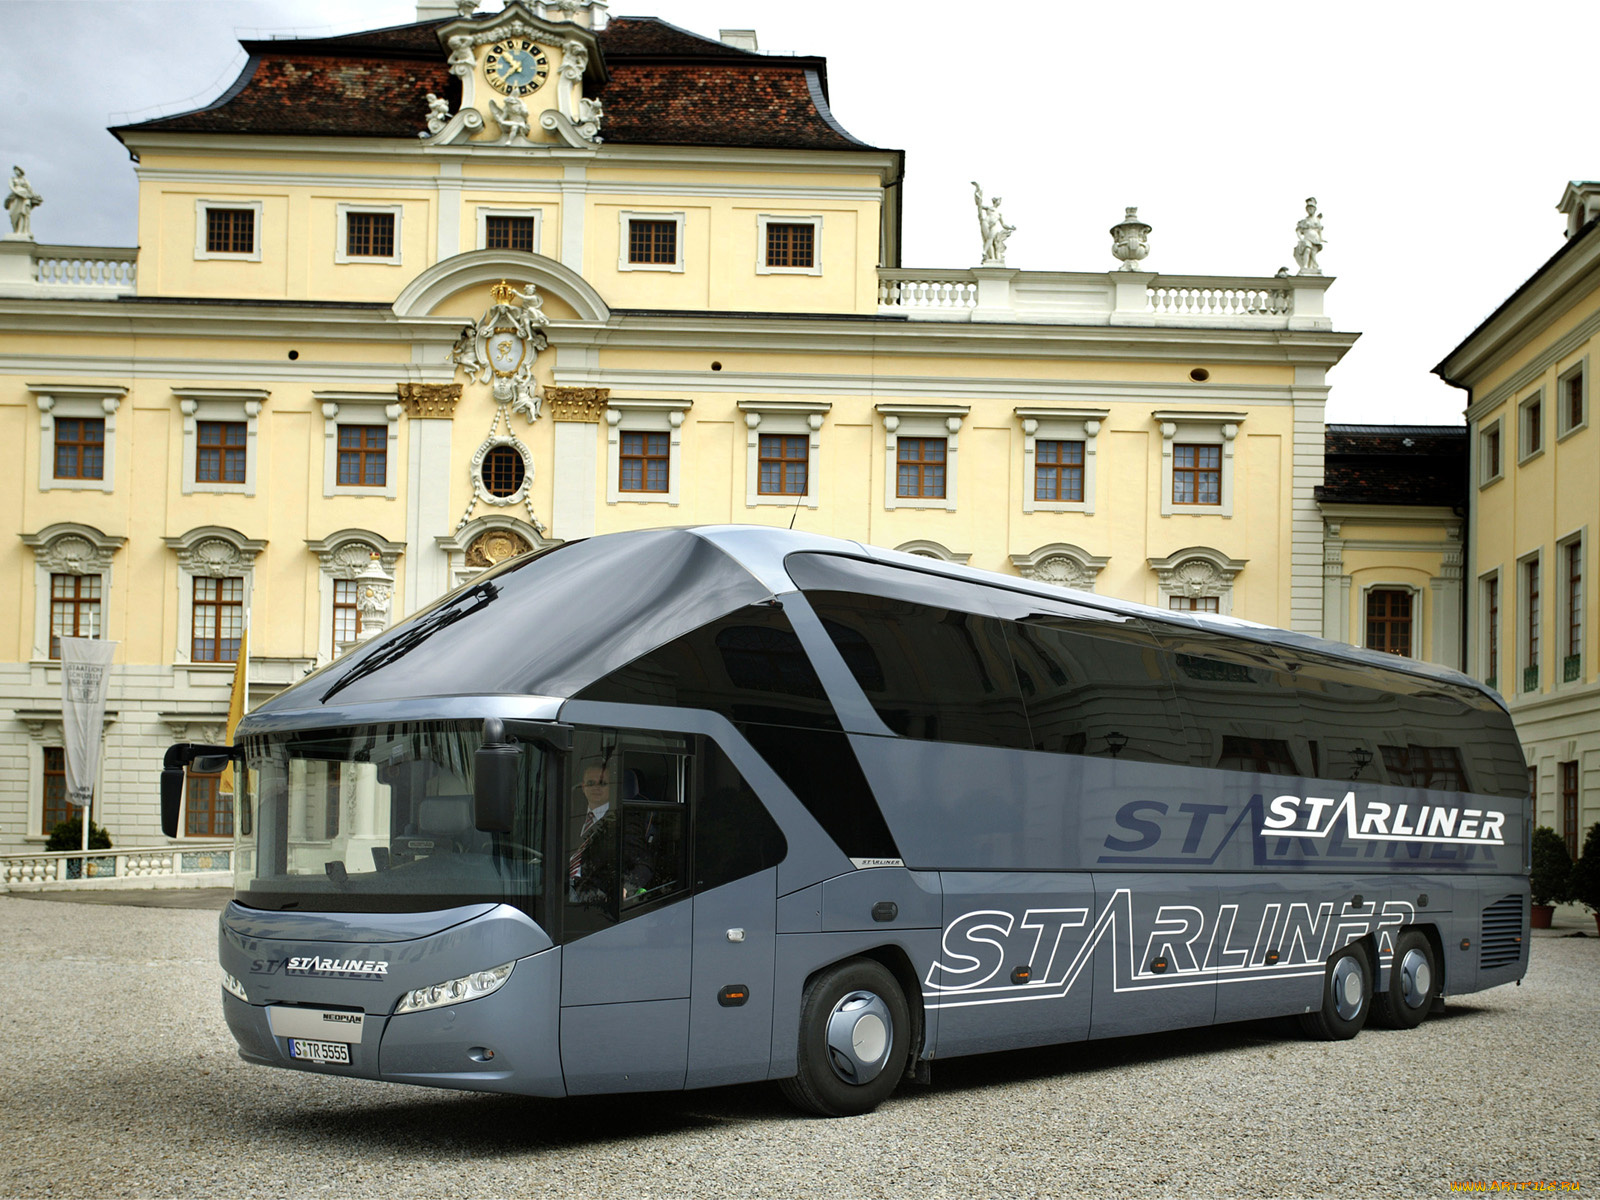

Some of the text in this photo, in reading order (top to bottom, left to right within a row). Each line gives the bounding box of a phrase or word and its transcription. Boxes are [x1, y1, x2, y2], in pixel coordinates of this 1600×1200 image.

[1261, 791, 1505, 845] STARLINER
[923, 888, 1415, 1008] STARLINER
[287, 955, 389, 974] STARLINER
[323, 1013, 361, 1024] NEOPLAN
[321, 1044, 347, 1060] 5555
